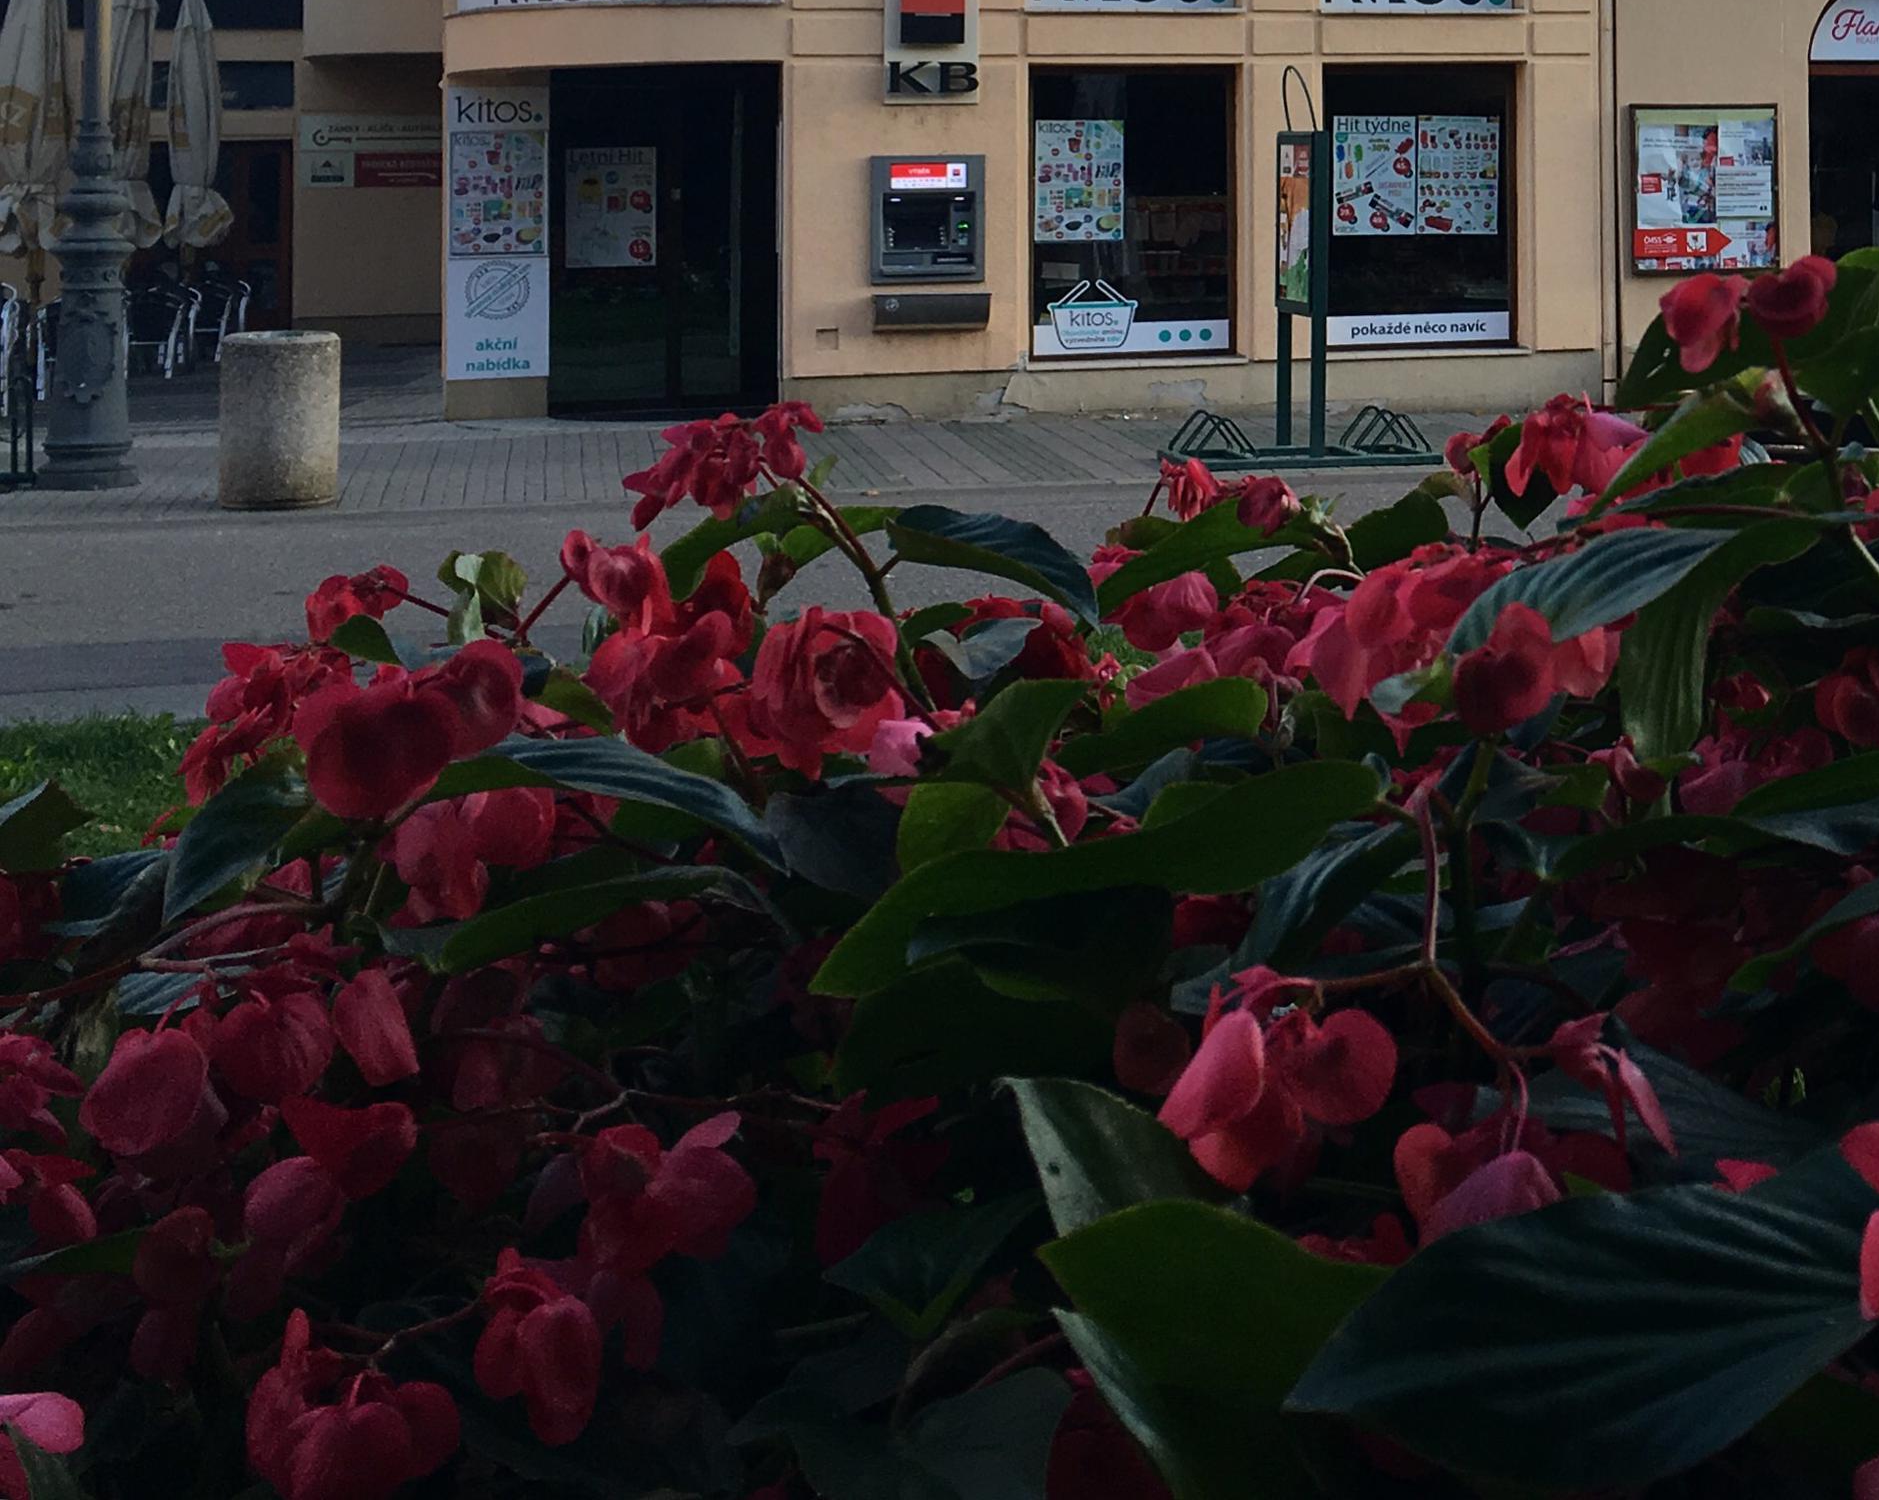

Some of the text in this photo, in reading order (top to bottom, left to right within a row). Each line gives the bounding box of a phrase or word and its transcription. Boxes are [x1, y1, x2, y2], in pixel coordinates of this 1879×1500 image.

[887, 61, 979, 94] KB
[1337, 117, 1411, 135] Hit týdne
[1351, 319, 1487, 338] pokaždé něco navíc
[475, 337, 518, 351] akční
[465, 357, 531, 372] nabídka
